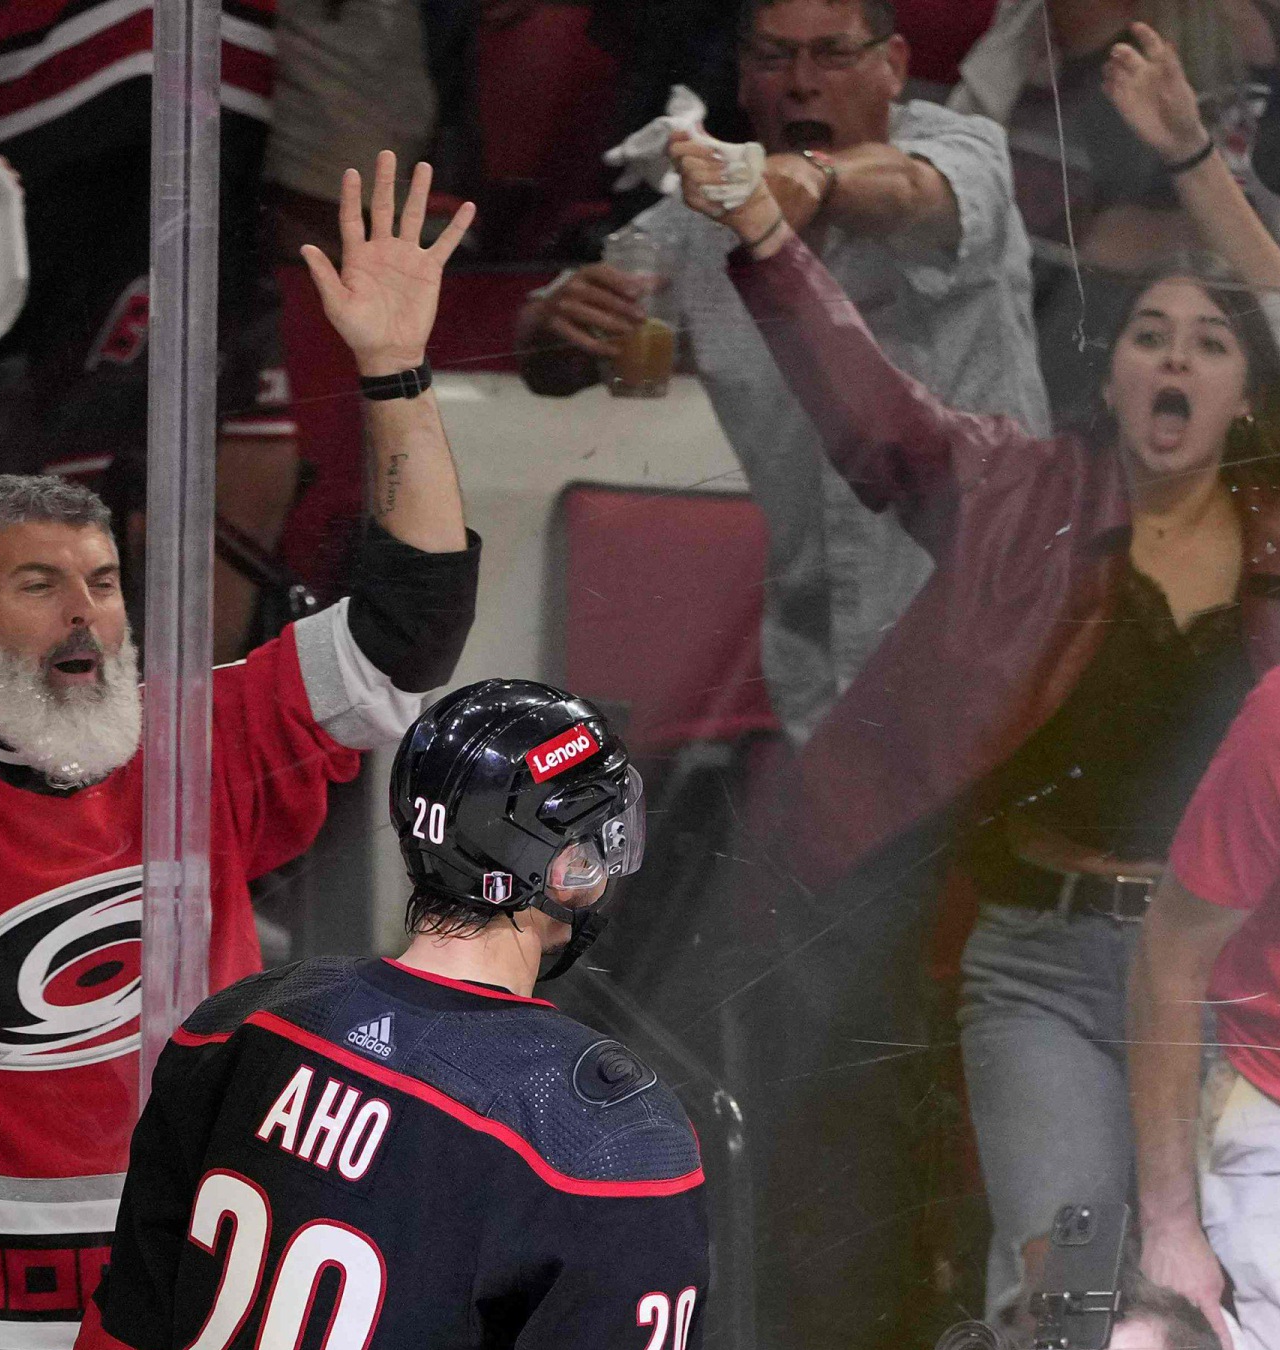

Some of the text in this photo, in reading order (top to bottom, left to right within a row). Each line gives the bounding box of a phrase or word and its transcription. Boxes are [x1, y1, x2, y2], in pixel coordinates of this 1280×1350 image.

[532, 734, 591, 774] Lenovo
[412, 796, 446, 845] 20
[347, 1030, 392, 1058] adidas
[255, 1063, 392, 1182] AHO
